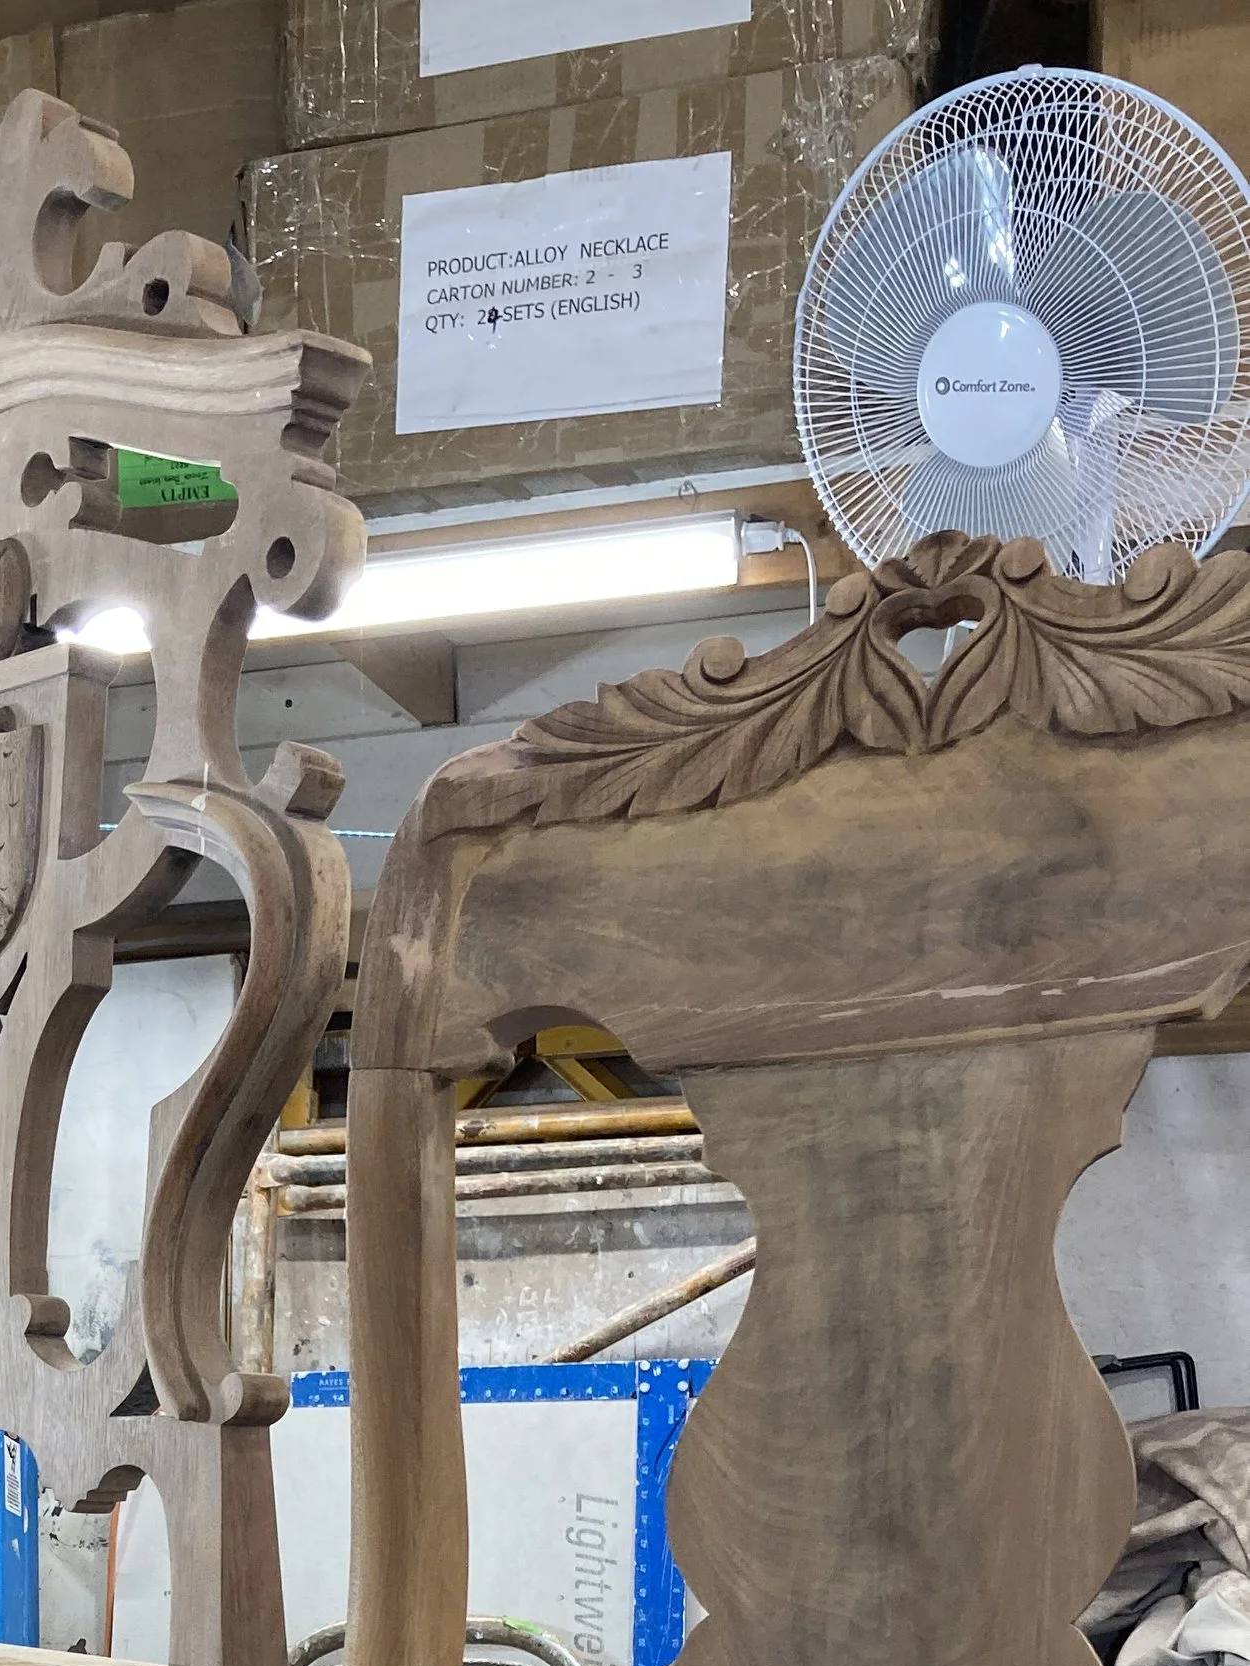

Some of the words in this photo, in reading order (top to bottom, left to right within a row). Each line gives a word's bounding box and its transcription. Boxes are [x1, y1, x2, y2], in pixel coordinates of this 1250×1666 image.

[579, 232, 670, 260] NECKLACE
[426, 281, 496, 305] CARTON
[501, 272, 579, 296] NUMBER:
[585, 269, 596, 285] 2
[632, 263, 643, 279] 3
[424, 312, 465, 334] QTY:
[550, 290, 641, 321] (ENGLISH)
[951, 379, 997, 393] Comfort
[160, 484, 210, 503] EMPTY
